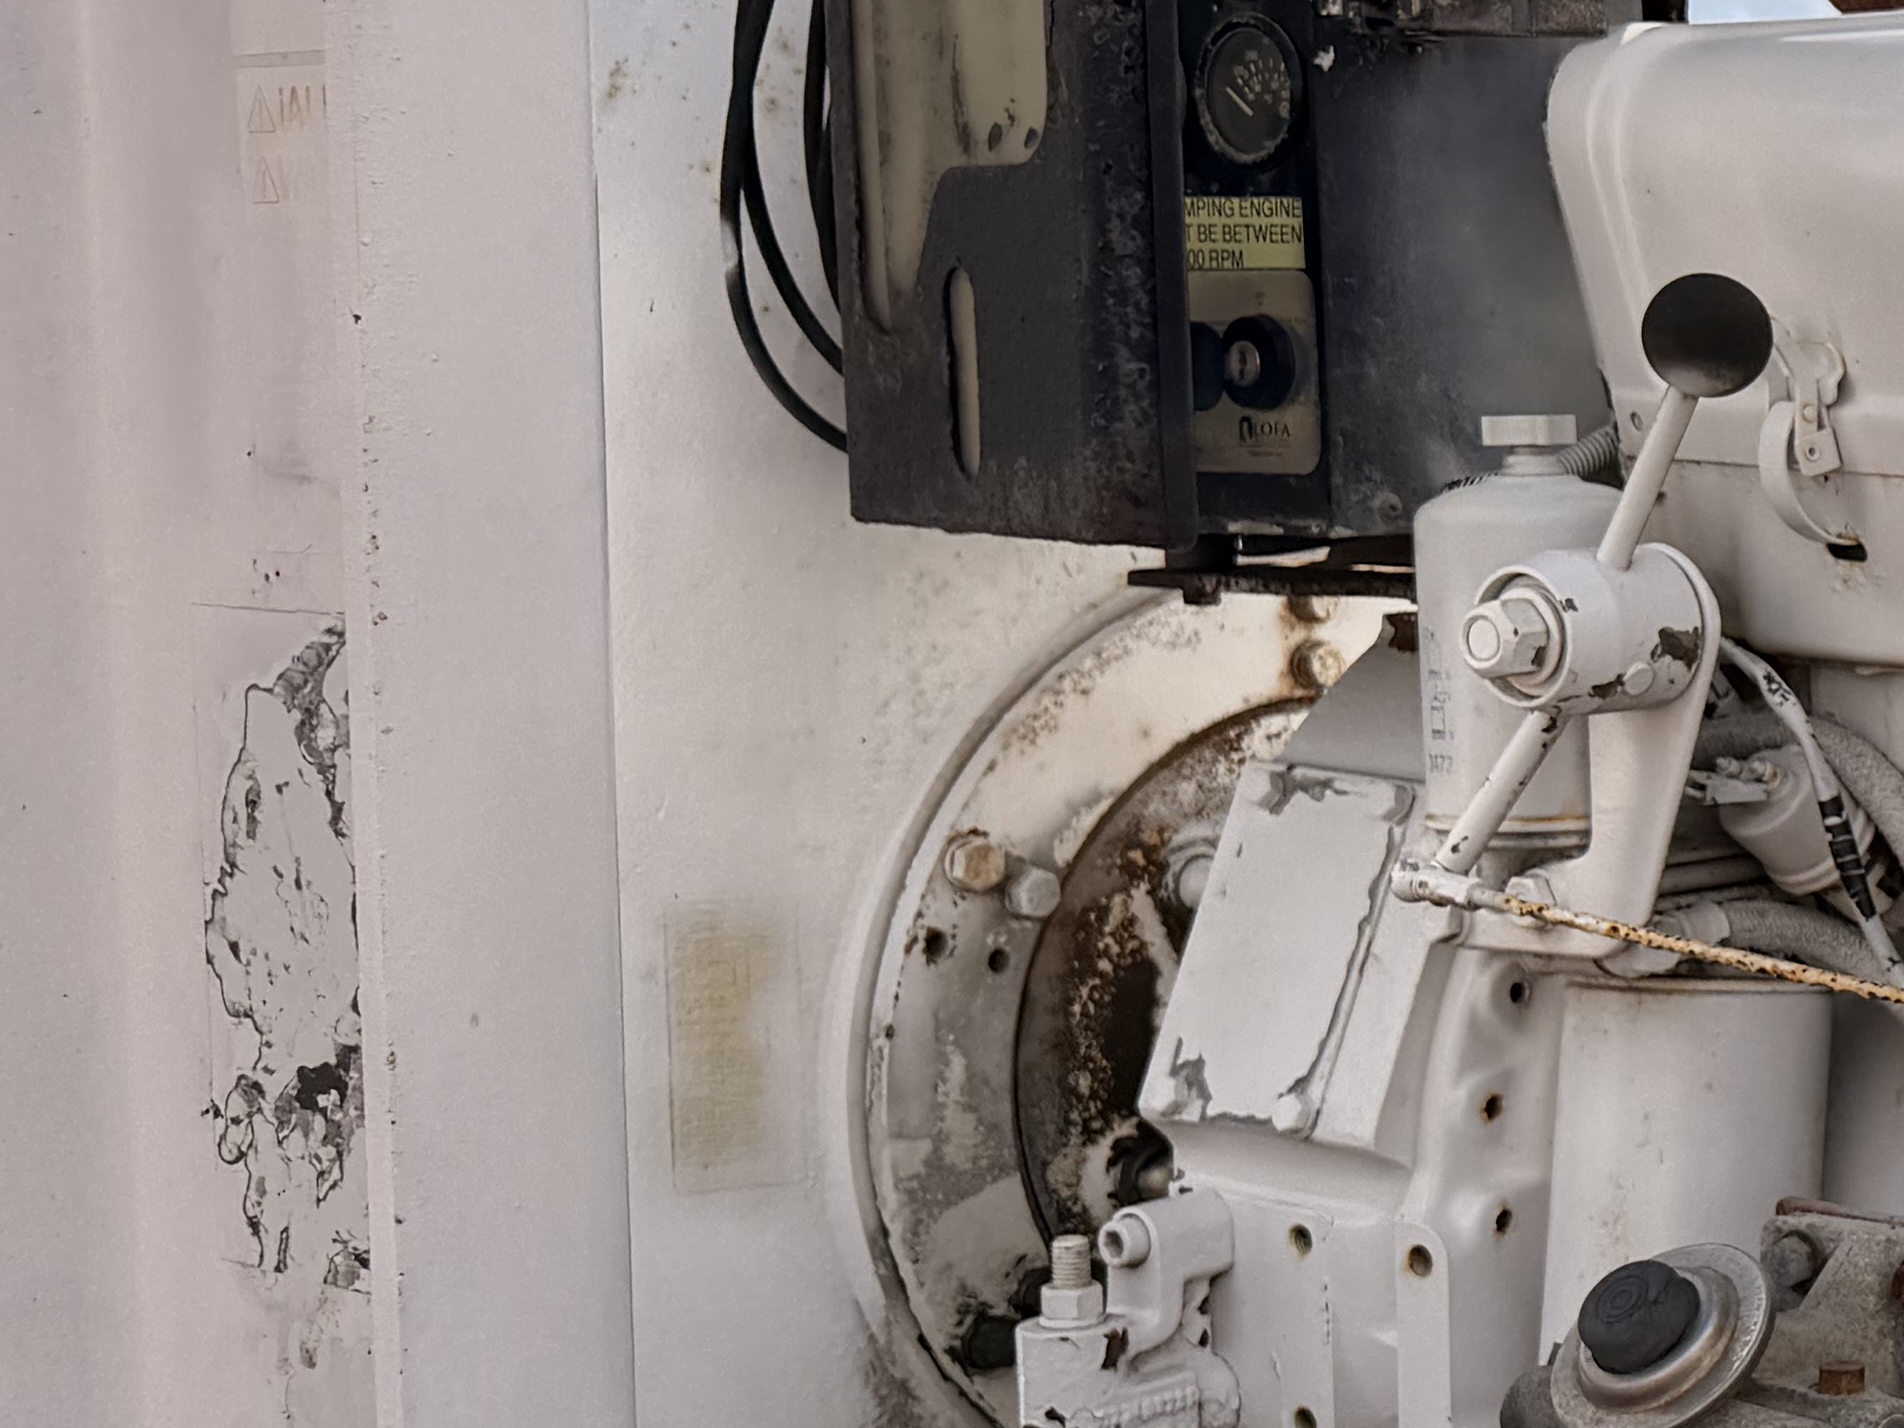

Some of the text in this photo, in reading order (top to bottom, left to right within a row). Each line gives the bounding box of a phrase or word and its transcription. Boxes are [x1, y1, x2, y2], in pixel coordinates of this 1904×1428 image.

[1240, 198, 1302, 218] ENGINE
[1197, 223, 1218, 244] BE
[1222, 223, 1302, 244] BETWEEN
[1209, 249, 1244, 270] RPM
